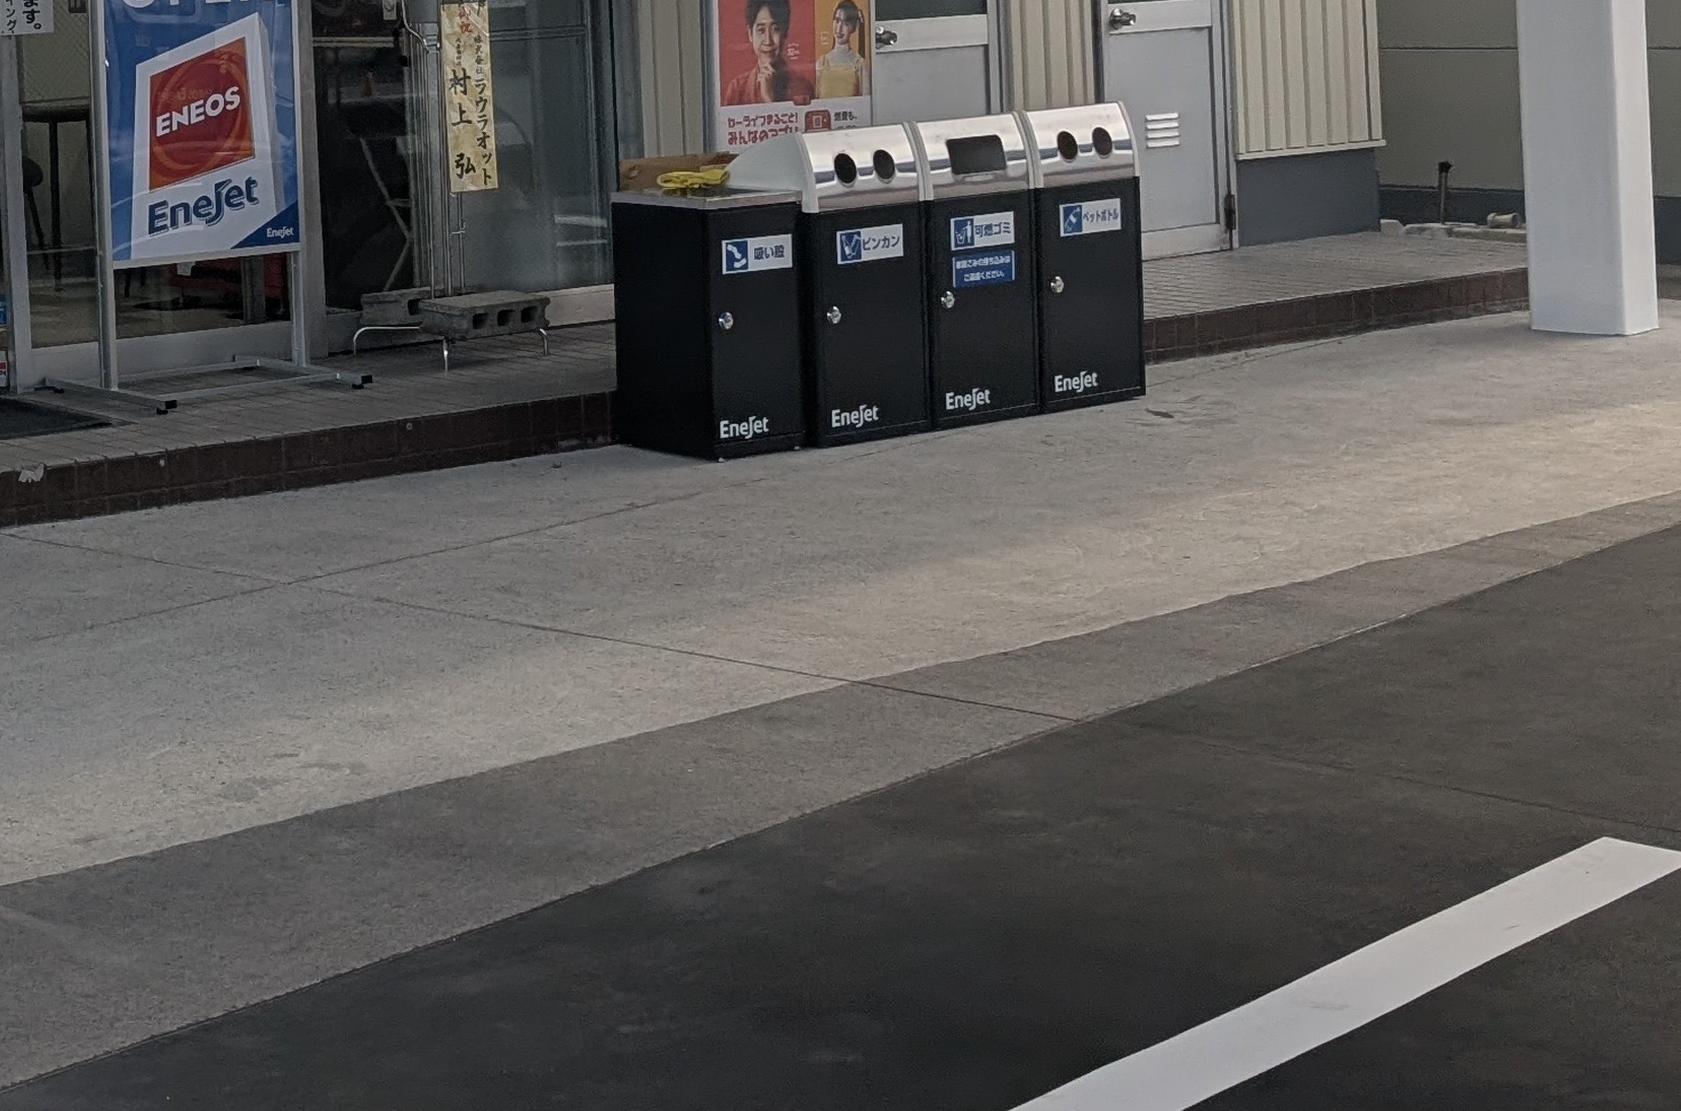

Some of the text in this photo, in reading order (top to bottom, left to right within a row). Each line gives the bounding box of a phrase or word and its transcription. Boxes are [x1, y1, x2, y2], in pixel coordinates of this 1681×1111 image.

[156, 86, 241, 138] ENEOS
[148, 176, 259, 237] EneJet
[1083, 208, 1119, 223] ペットボトル
[267, 226, 294, 239] EneJet
[975, 221, 1011, 237] 可燃ゴミ
[1054, 370, 1098, 393] EneJet
[945, 388, 990, 411] EneJet
[720, 415, 769, 440] EneJet
[831, 404, 879, 429] EneJet
